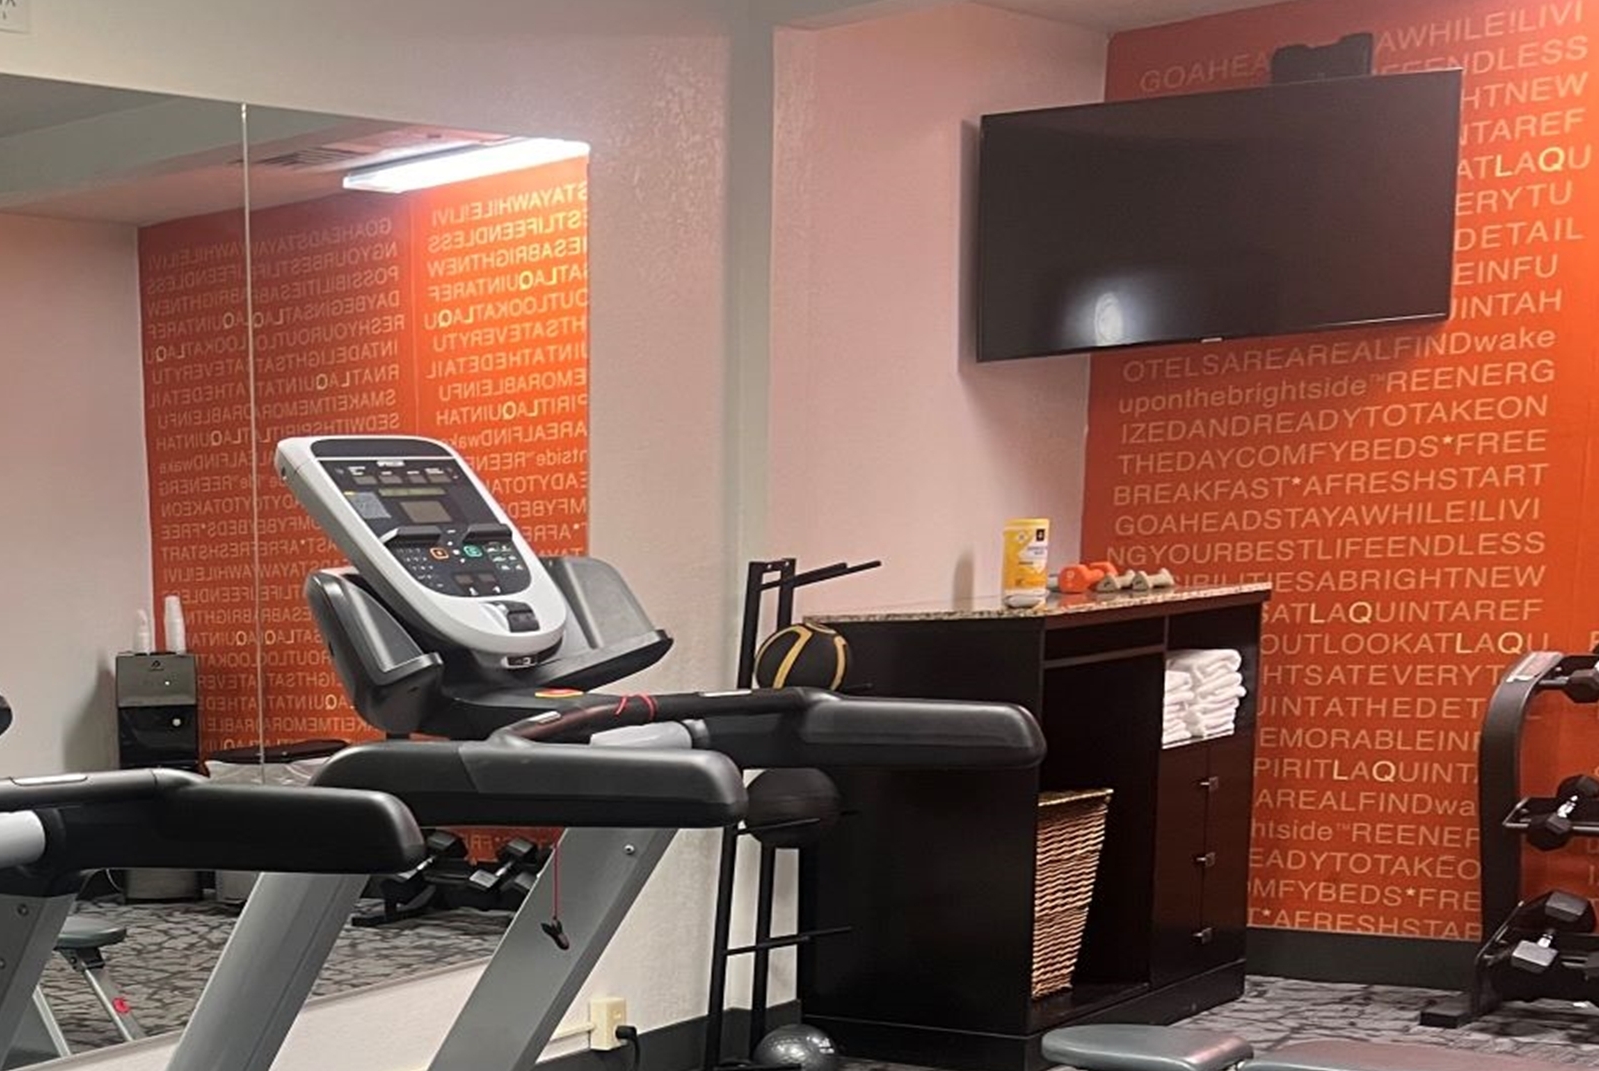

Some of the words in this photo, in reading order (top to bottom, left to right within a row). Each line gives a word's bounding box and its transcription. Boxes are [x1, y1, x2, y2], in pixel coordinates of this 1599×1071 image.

[1455, 180, 1573, 216] ERYTU
[1454, 217, 1585, 252] DETAIL
[1453, 254, 1558, 286] EINFU
[1120, 394, 1550, 444] IZEDANDREADYTOTAKEON
[1106, 531, 1547, 566] NGYOURBESTLIFEENDLESS
